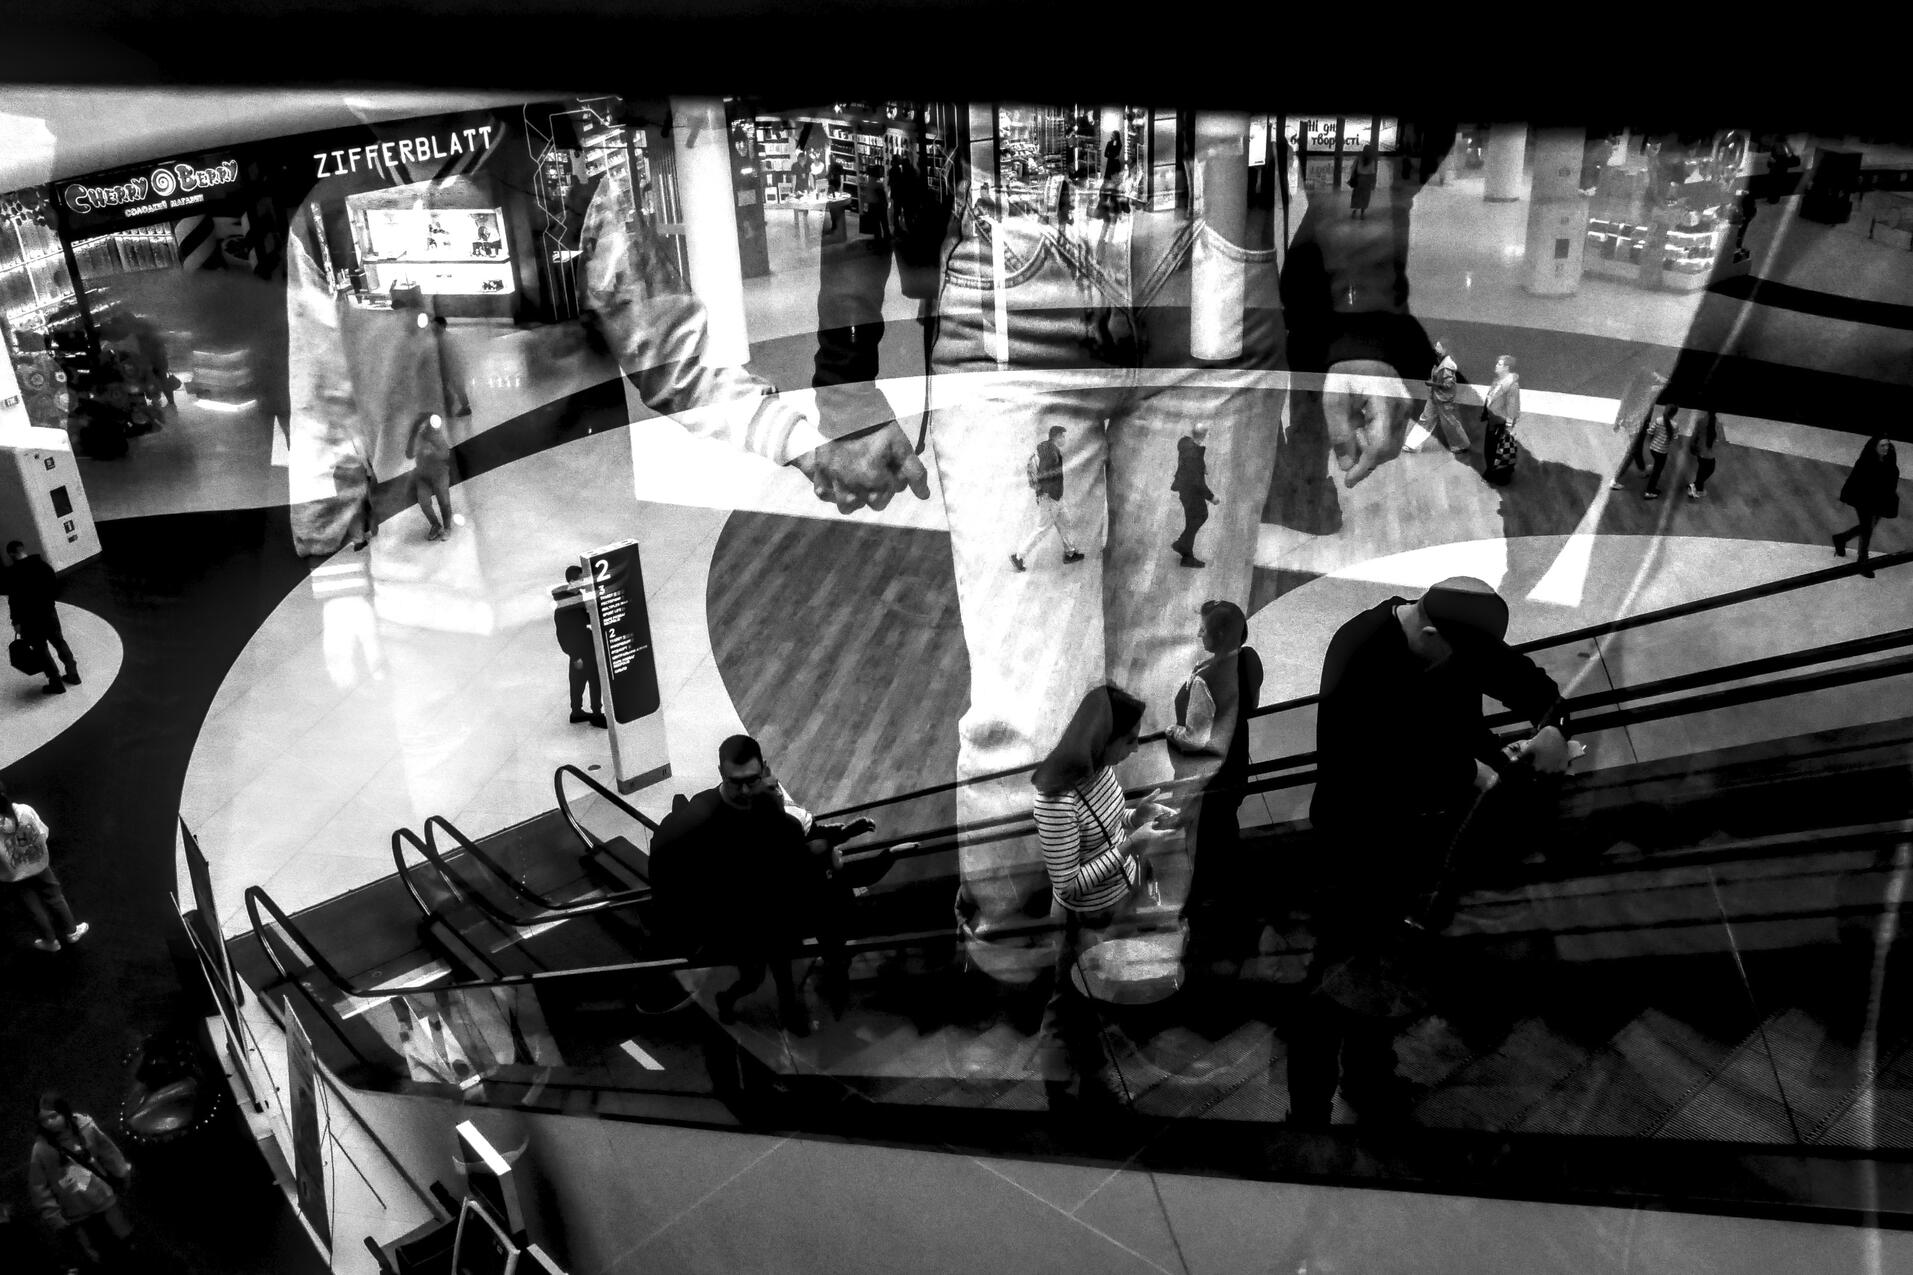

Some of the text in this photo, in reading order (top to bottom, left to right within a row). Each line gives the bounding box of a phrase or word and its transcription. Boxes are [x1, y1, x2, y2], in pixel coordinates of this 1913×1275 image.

[1311, 133, 1360, 149] творсті
[313, 126, 492, 178] ZIFFERBLATT
[64, 159, 238, 214] CHERRY BERRY
[595, 559, 611, 582] 2
[598, 584, 606, 596] 3
[608, 628, 616, 638] 2
